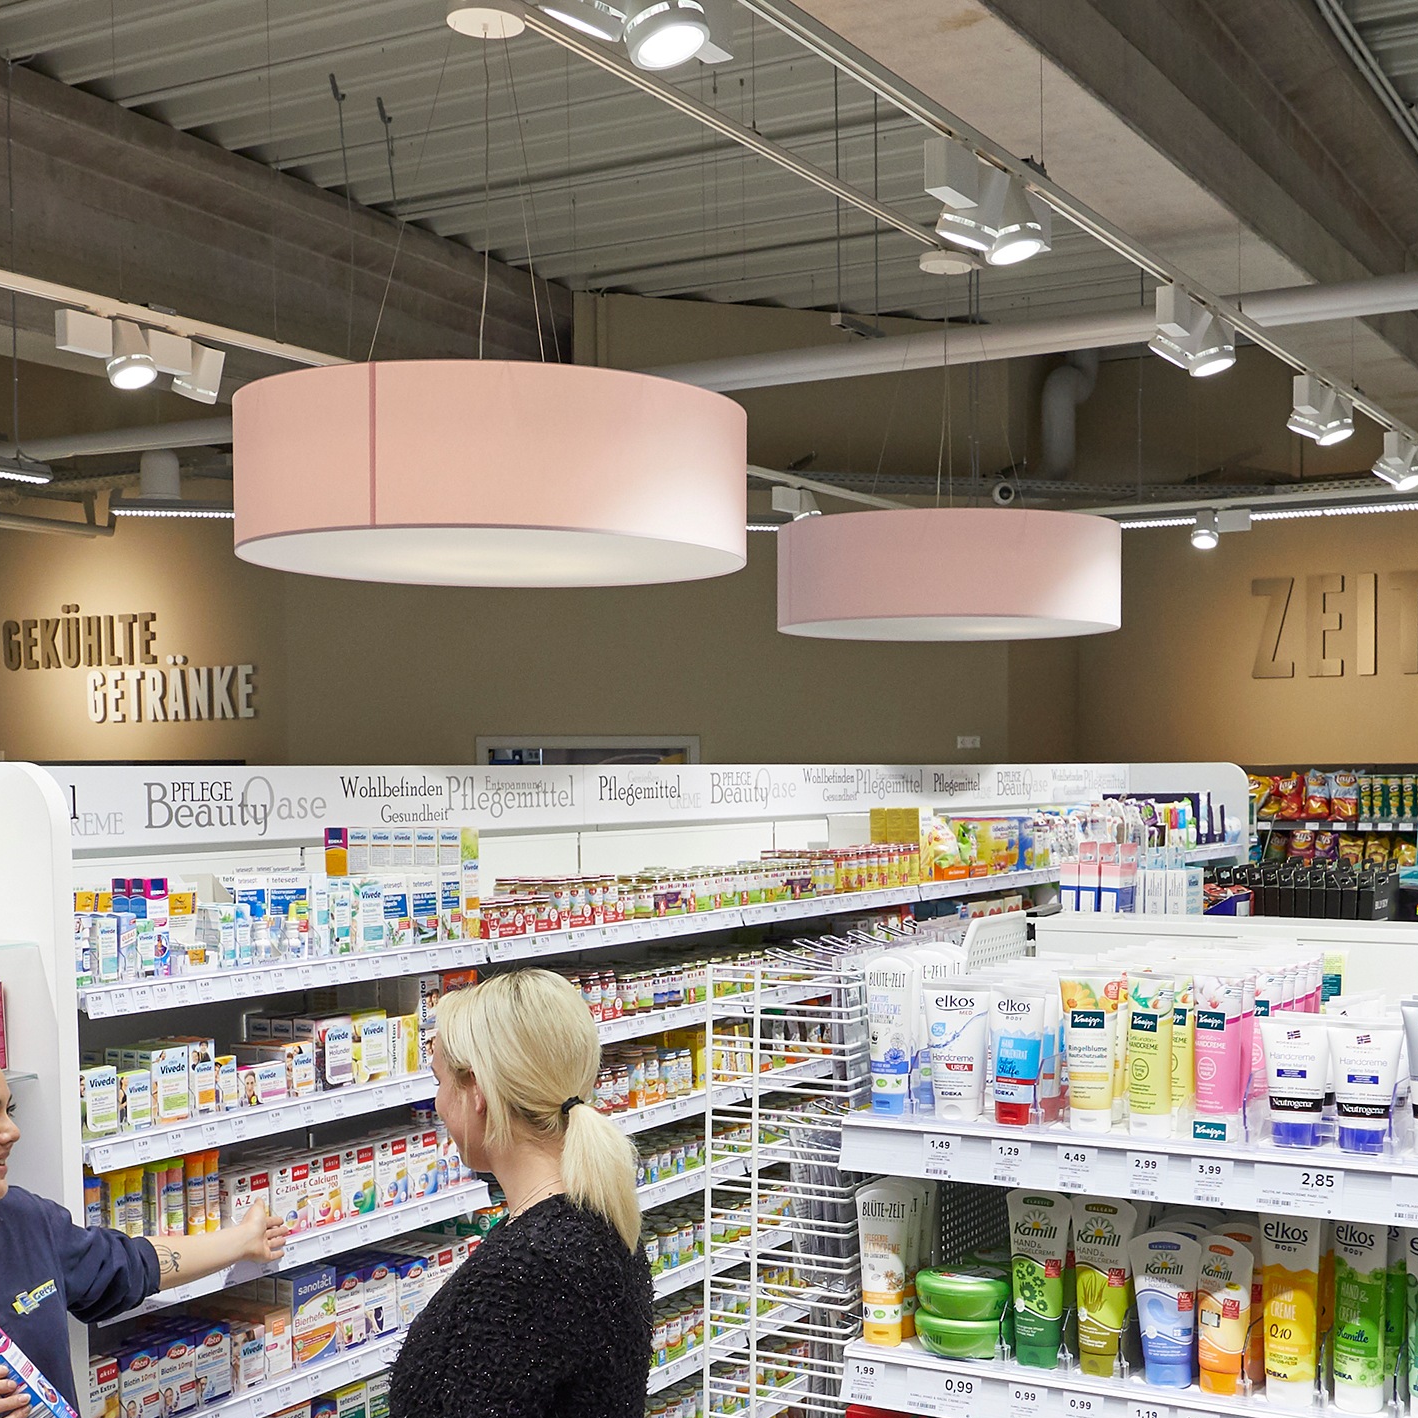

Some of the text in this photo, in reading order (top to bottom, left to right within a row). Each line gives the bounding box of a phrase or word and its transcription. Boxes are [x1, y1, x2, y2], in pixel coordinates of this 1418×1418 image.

[2, 604, 158, 670] GEKÜHLTE
[87, 655, 257, 722] GETRÄNKE
[723, 771, 751, 785] PFLEGE
[803, 768, 855, 784] Wohlbefinden
[171, 781, 232, 802] PFLEGE
[340, 775, 443, 799] Wohlbefinden
[599, 774, 681, 806] Pflegemittel
[711, 772, 769, 809] Beauty
[855, 769, 923, 800] Pflegemittel
[933, 772, 980, 797] Pflegemittel
[446, 775, 575, 818] Pflegemittel
[144, 776, 327, 835] Beauty Oase
[381, 804, 448, 824] Gesundheit
[271, 876, 298, 884] tetesept
[361, 890, 381, 899] Vivede
[935, 995, 975, 1008] elkos
[998, 1000, 1031, 1012] elkos
[1198, 1014, 1223, 1028] Kneipp
[328, 1030, 349, 1042] Vivede
[1068, 1045, 1107, 1053] Ringelblume
[933, 1053, 974, 1062] Handcreme
[160, 1062, 185, 1076] Vivede
[89, 1074, 115, 1088] Vivede
[930, 1140, 951, 1150] 1,49
[308, 1173, 338, 1188] Calcium
[1301, 1172, 1335, 1188] 2,85
[235, 1194, 251, 1208] A-Z
[1076, 1230, 1121, 1248] Kamill
[1335, 1223, 1375, 1248] elkos
[298, 1275, 332, 1296] sanotact
[100, 1368, 117, 1379] aktiv
[161, 1358, 193, 1375] Biotin 10mg
[123, 1370, 156, 1388] Biotin 10mg
